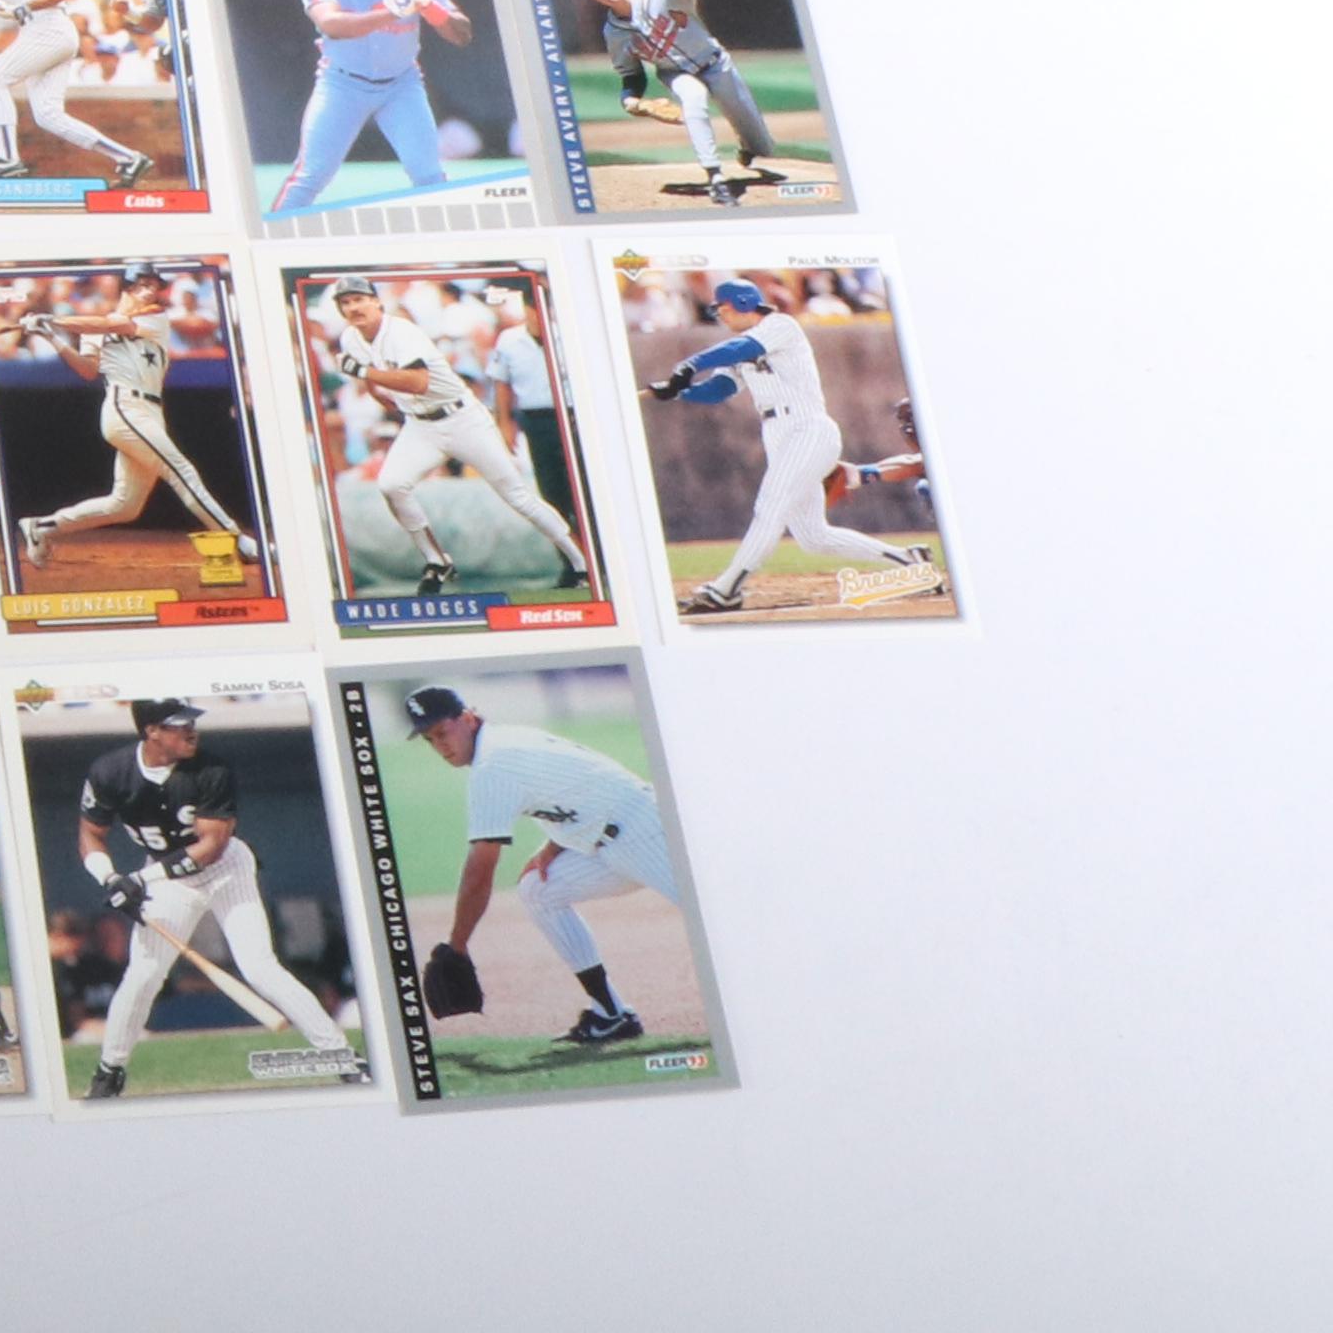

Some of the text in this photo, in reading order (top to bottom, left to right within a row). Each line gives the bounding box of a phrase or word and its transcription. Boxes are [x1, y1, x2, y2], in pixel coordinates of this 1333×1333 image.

[554, 85, 578, 143] AVERY
[566, 150, 592, 208] STEVE
[124, 194, 165, 208] Cubs
[485, 187, 526, 197] FLEER
[788, 255, 879, 267] PAUL MOLITOR
[12, 597, 145, 615] LUIS GONZALEZ
[347, 600, 479, 619] WADE BOGGS
[211, 680, 305, 693] SAMMY SOSA
[346, 690, 434, 1093] STEVE SAX CHICAGO WHITE SOX 2B
